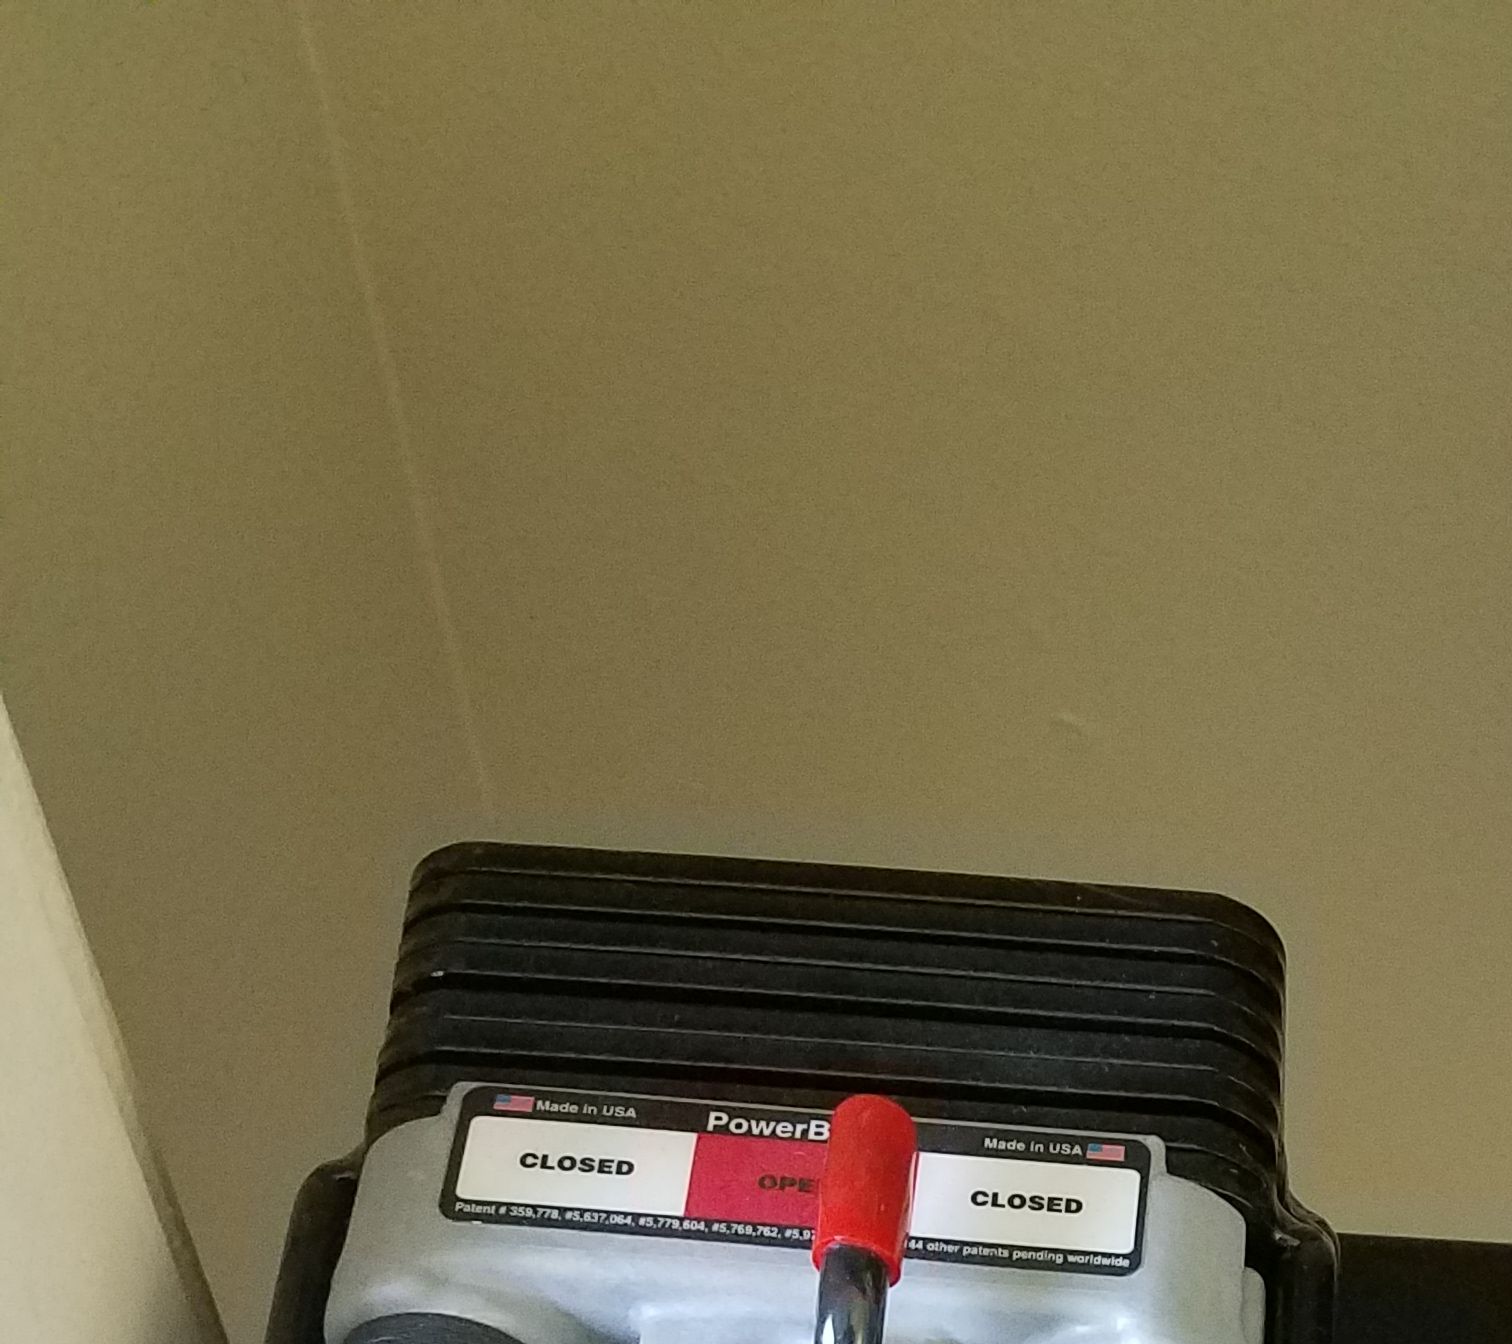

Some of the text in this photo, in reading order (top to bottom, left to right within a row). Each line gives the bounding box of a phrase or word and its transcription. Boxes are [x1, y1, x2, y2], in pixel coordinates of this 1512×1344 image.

[536, 1100, 637, 1119] Made in USA
[707, 1111, 830, 1141] PowerB
[984, 1137, 1083, 1155] Made in USA
[519, 1152, 635, 1176] CLOSED
[758, 1174, 816, 1192] OPE
[455, 1201, 496, 1214] Patent
[970, 1190, 1083, 1214] CLOSED
[926, 1241, 960, 1254] other
[962, 1245, 1009, 1257] patents
[1012, 1250, 1064, 1263] pending
[1067, 1255, 1131, 1268] worldwide
